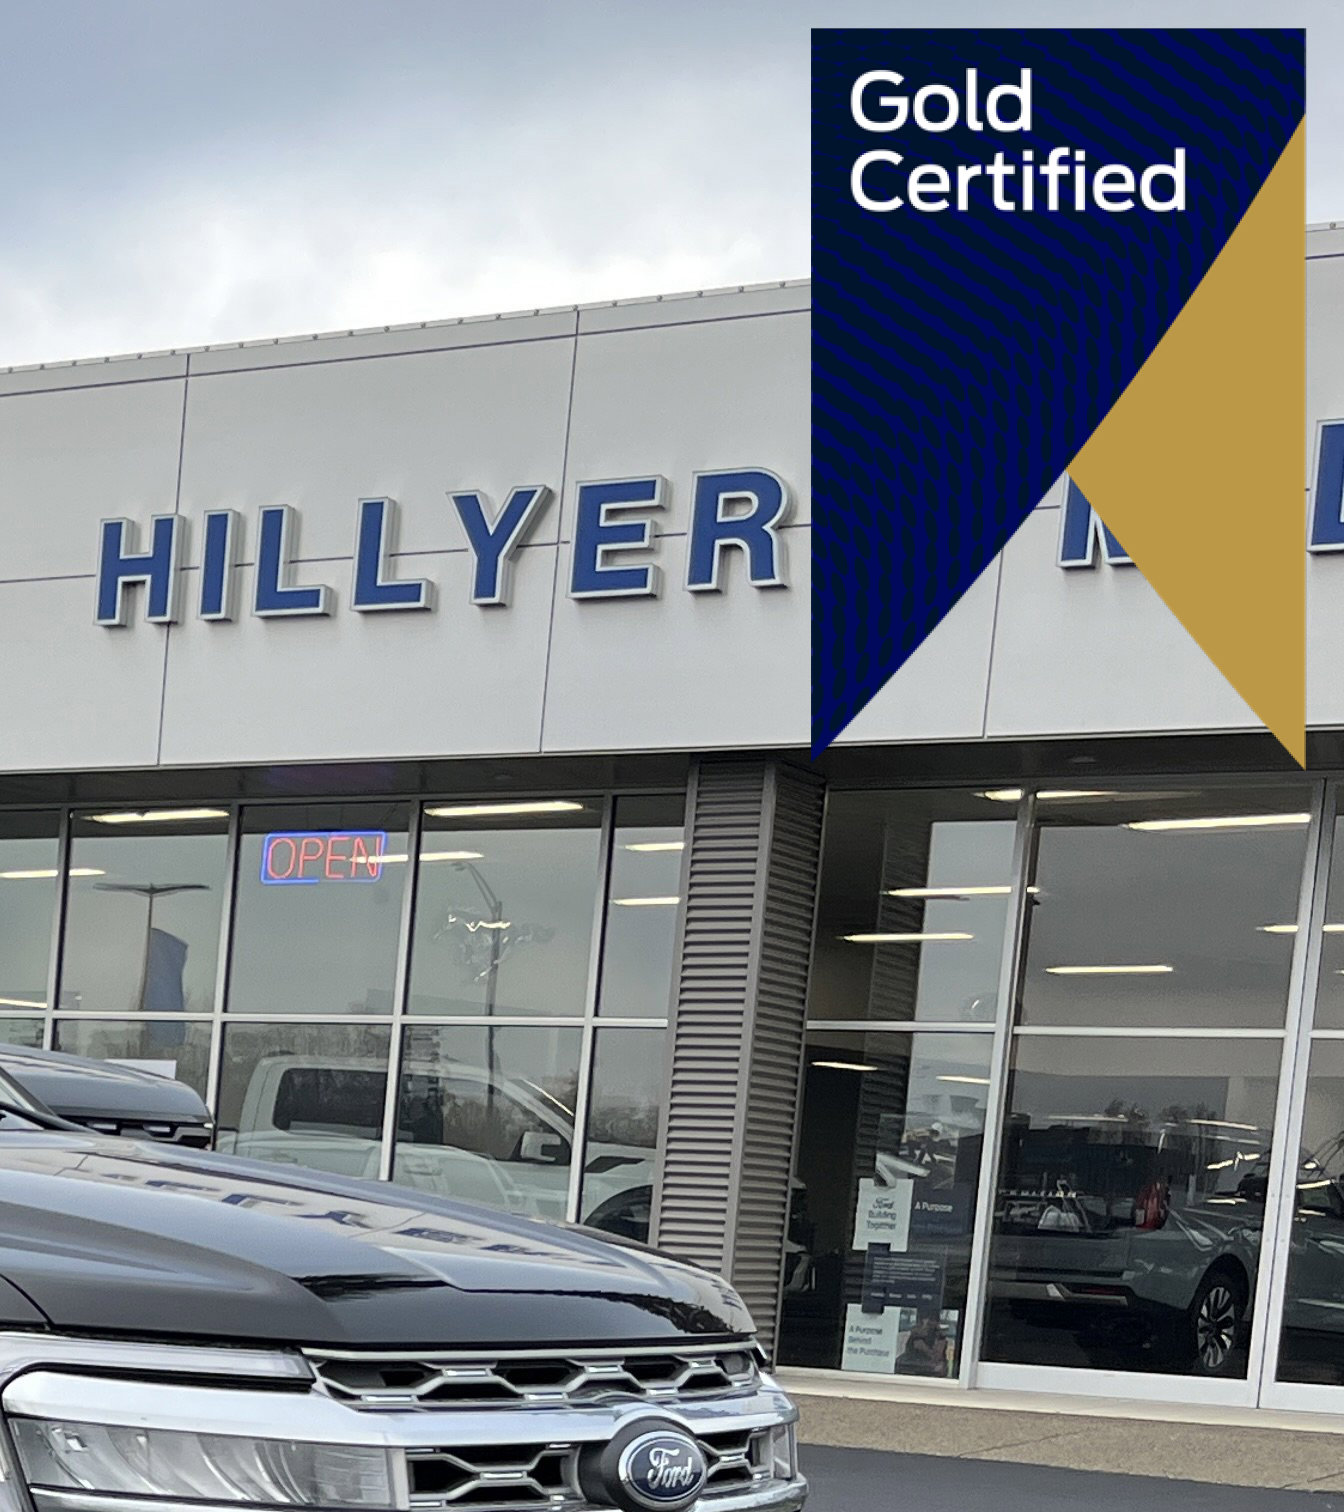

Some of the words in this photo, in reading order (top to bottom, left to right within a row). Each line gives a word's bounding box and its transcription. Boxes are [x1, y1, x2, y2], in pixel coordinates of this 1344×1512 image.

[93, 465, 794, 627] HILLYER
[266, 836, 381, 879] OPEN
[647, 1447, 695, 1490] Ford
